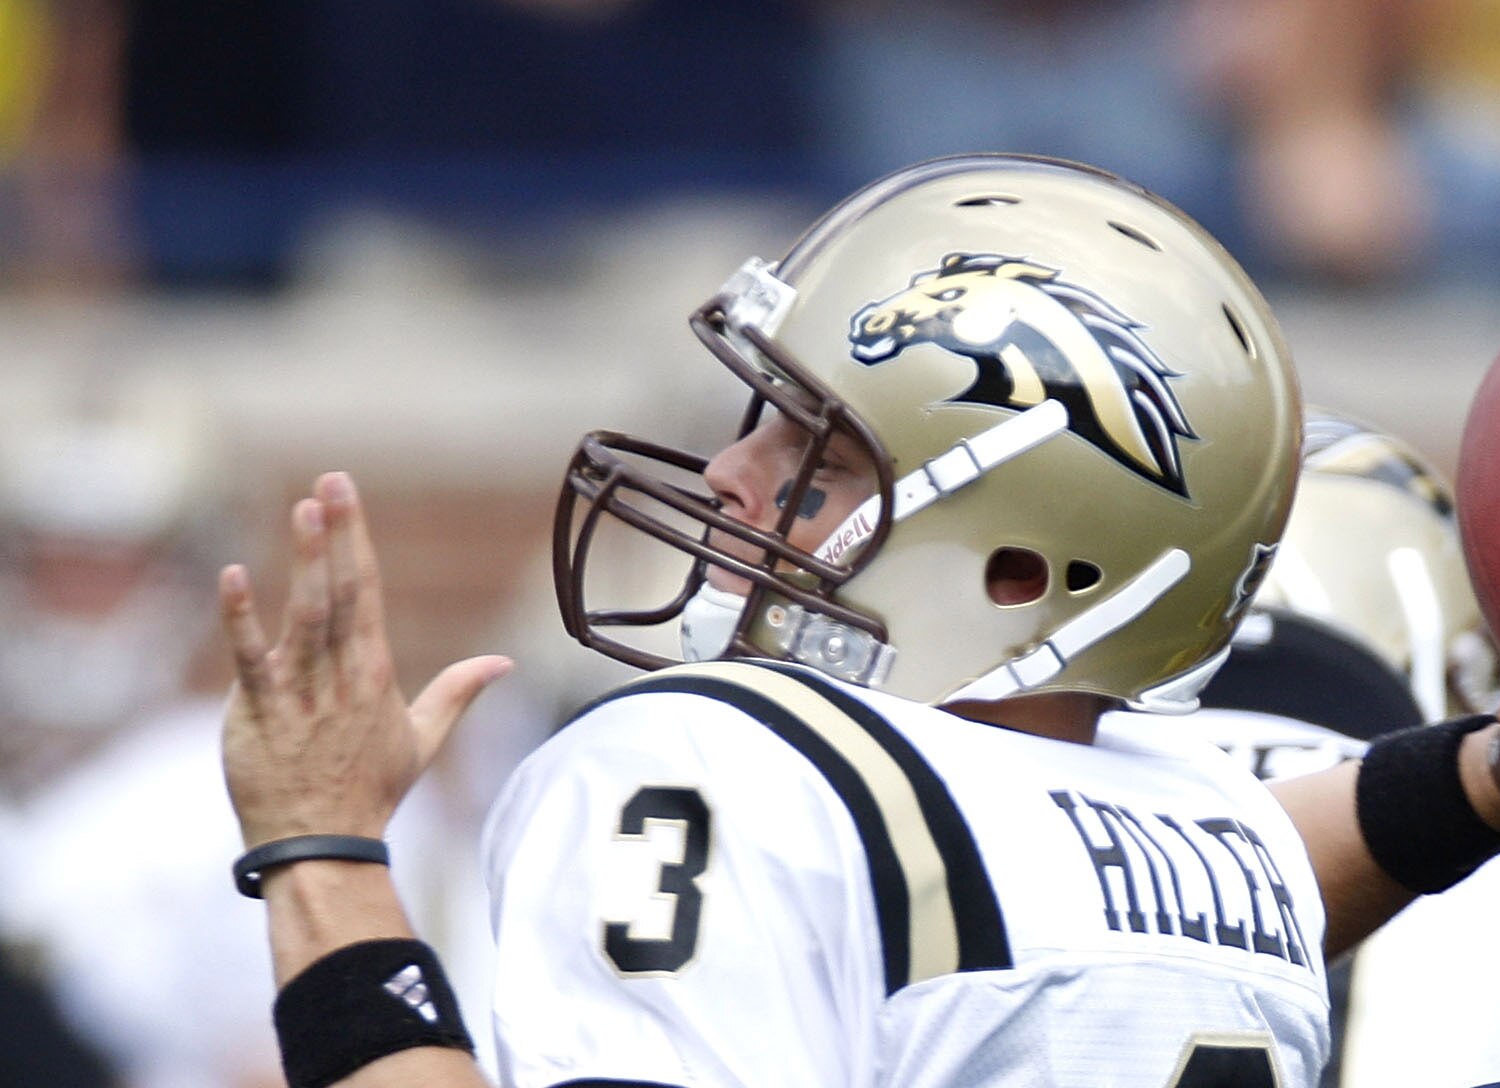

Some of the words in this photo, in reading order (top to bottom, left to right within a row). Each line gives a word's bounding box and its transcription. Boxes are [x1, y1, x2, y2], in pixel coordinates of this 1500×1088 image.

[824, 512, 873, 564] ddell
[601, 782, 714, 979] 3
[1047, 789, 1316, 975] HILLER
